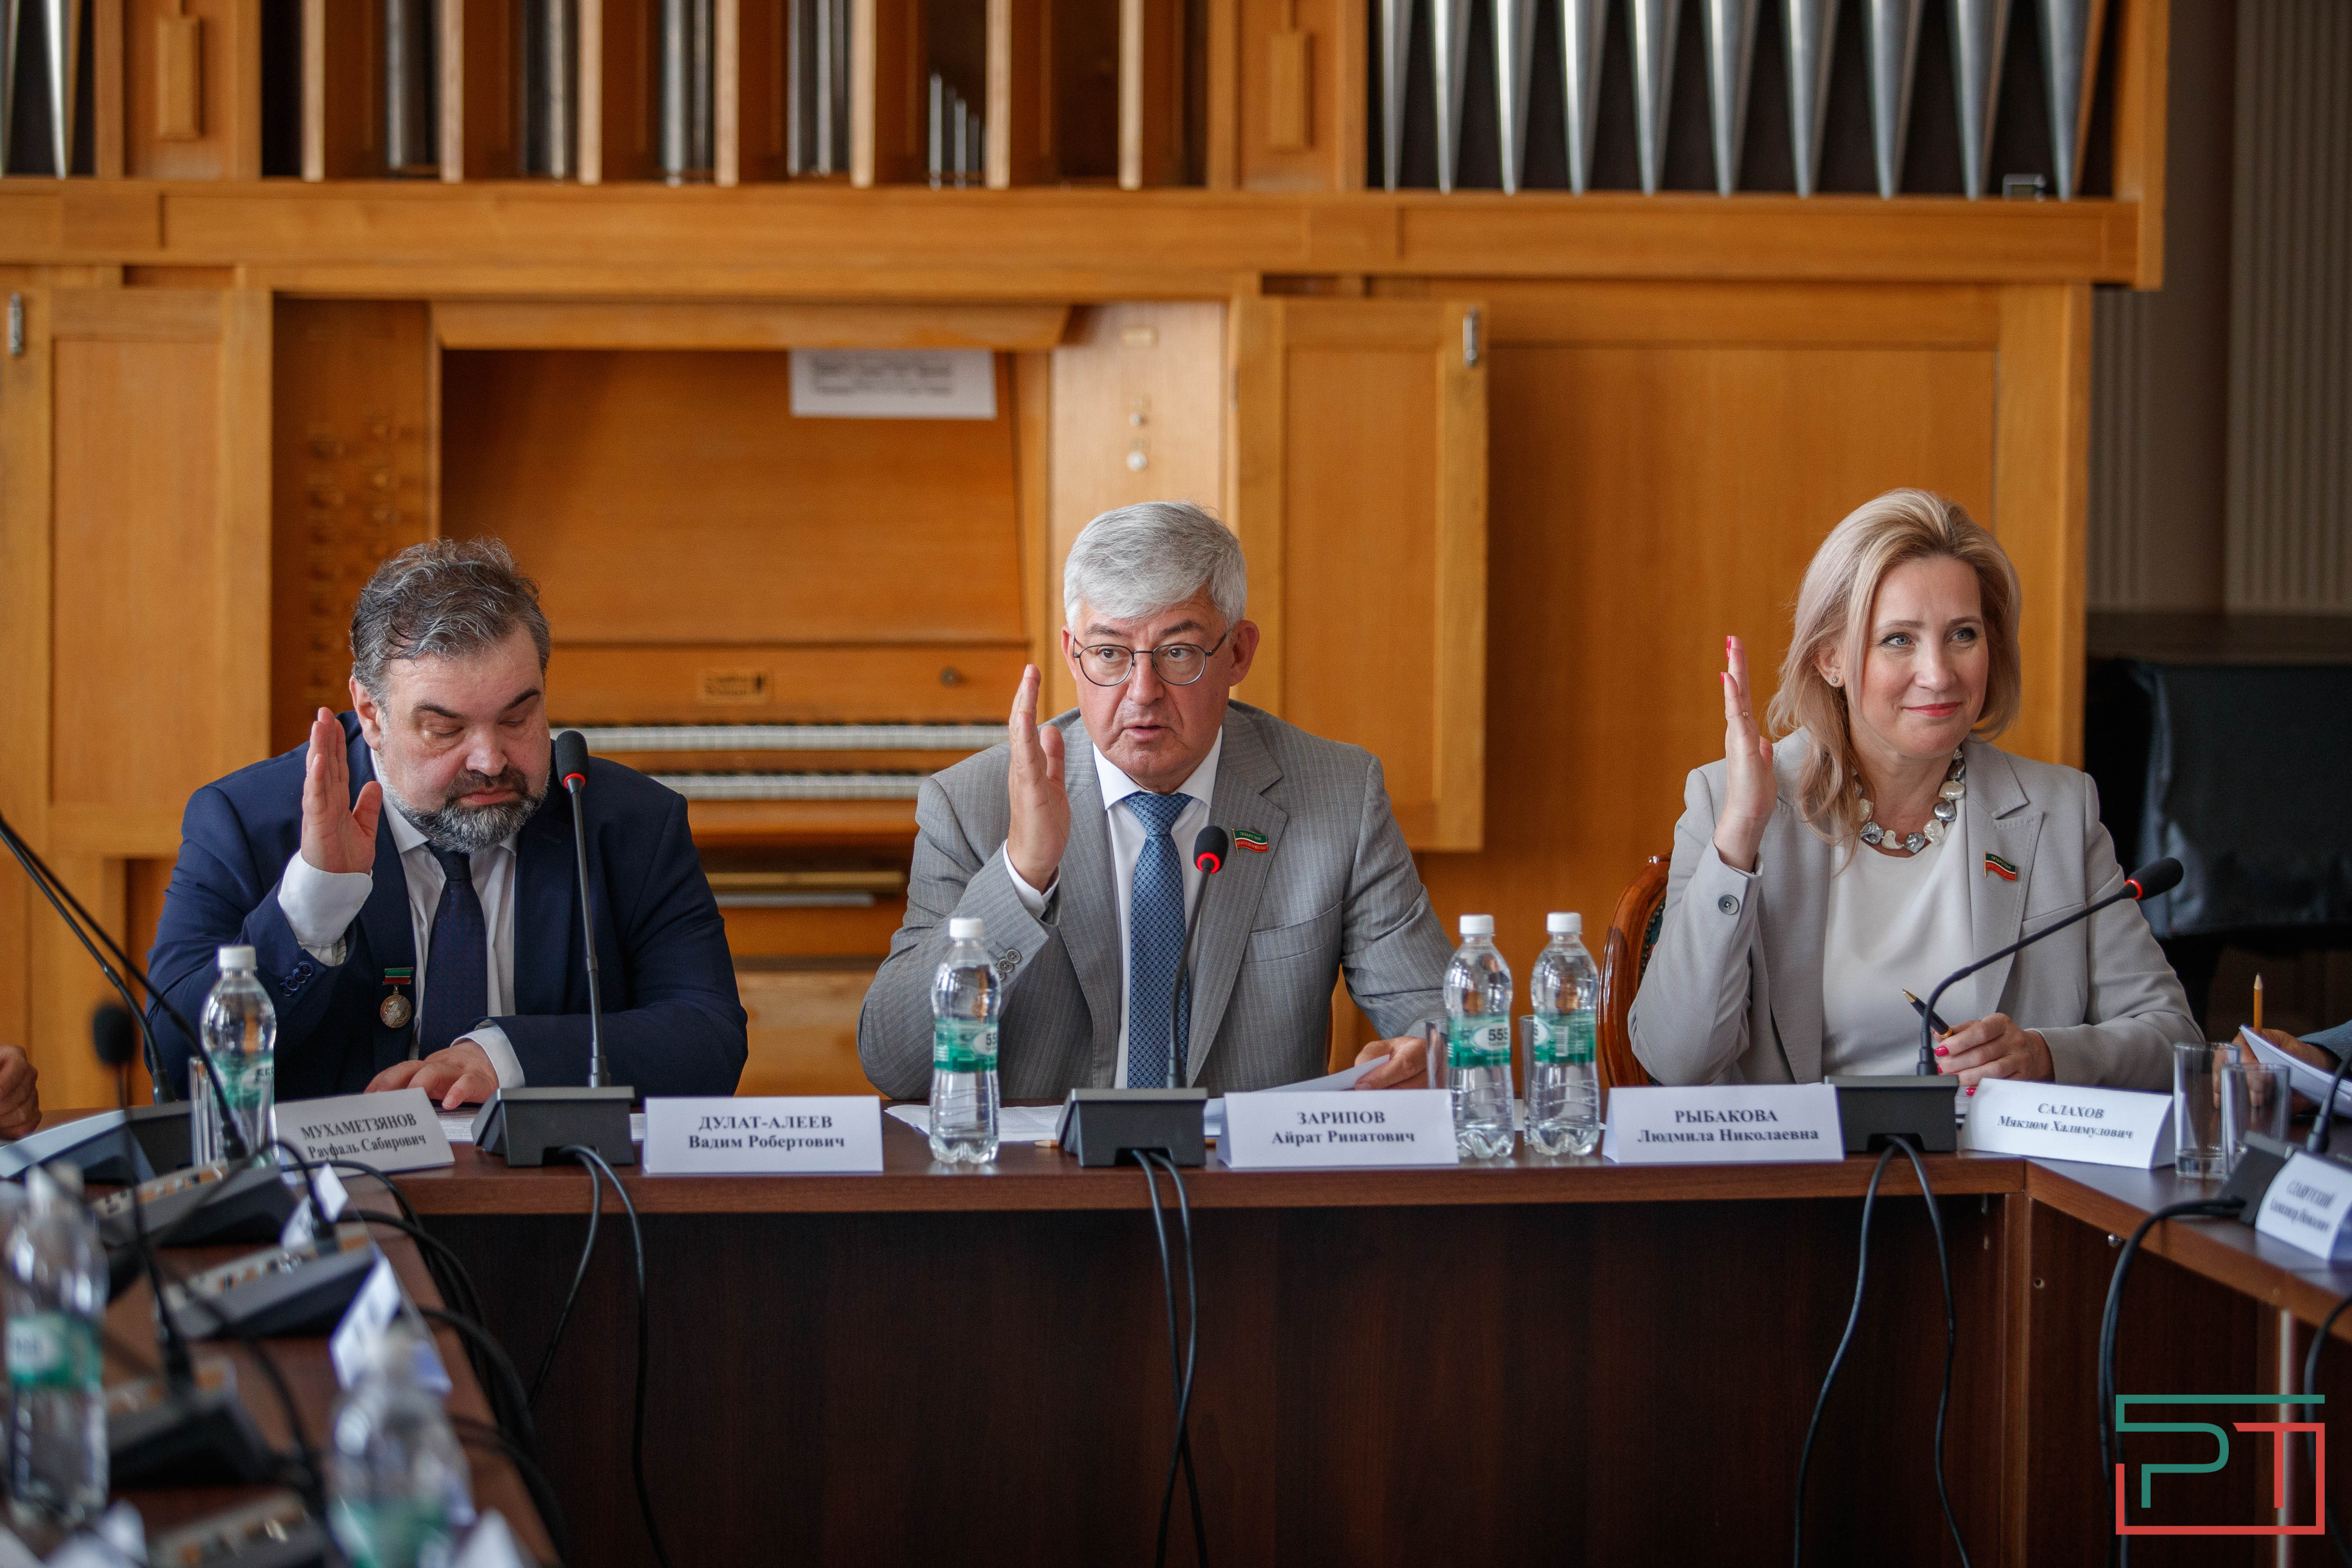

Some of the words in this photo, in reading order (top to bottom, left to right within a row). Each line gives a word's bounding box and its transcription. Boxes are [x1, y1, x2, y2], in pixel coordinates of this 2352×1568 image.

[1297, 1110, 1386, 1125] ЗАРИПОВ
[1674, 1109, 1778, 1123] РЫБАКОВА
[2037, 1103, 2104, 1118] САЛАХОВ
[301, 1113, 417, 1139] МУХАМЕТЗЯНОВ
[698, 1115, 833, 1131] ДУЛАТ-АЛЕЕВ
[1998, 1116, 2048, 1130] Мякзюм
[2051, 1120, 2133, 1138] Халимулович
[688, 1135, 742, 1149] Вадим
[748, 1135, 845, 1151] Робертович
[1272, 1131, 1322, 1146] Айрат
[1327, 1130, 1415, 1143] Ринатович
[1637, 1129, 1715, 1143] Людмила
[1719, 1128, 1819, 1142] Николаевна
[308, 1143, 360, 1161] Рауфаль
[361, 1134, 426, 1152] Сабирович
